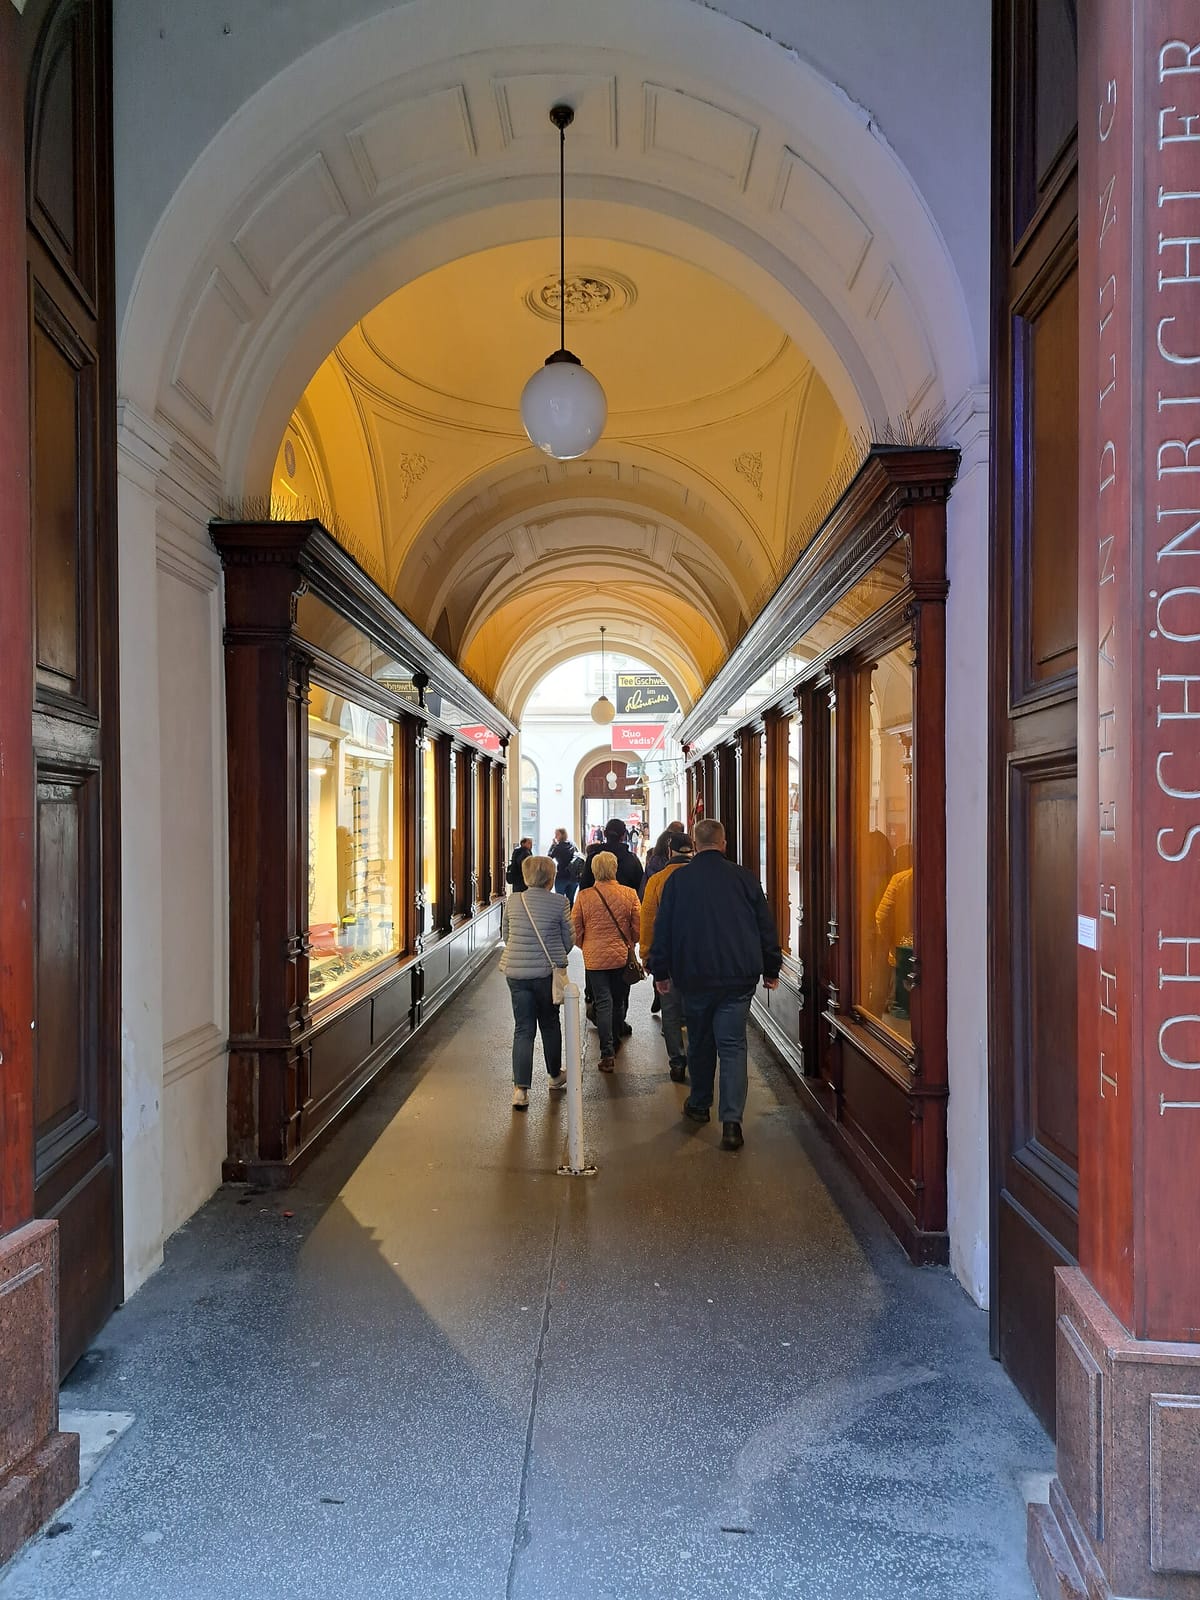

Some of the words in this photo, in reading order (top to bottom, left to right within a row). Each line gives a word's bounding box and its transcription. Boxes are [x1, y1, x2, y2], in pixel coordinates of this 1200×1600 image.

[620, 677, 634, 686] Tee
[646, 687, 656, 695] im
[621, 729, 641, 739] Quo
[629, 736, 655, 745] vadis?
